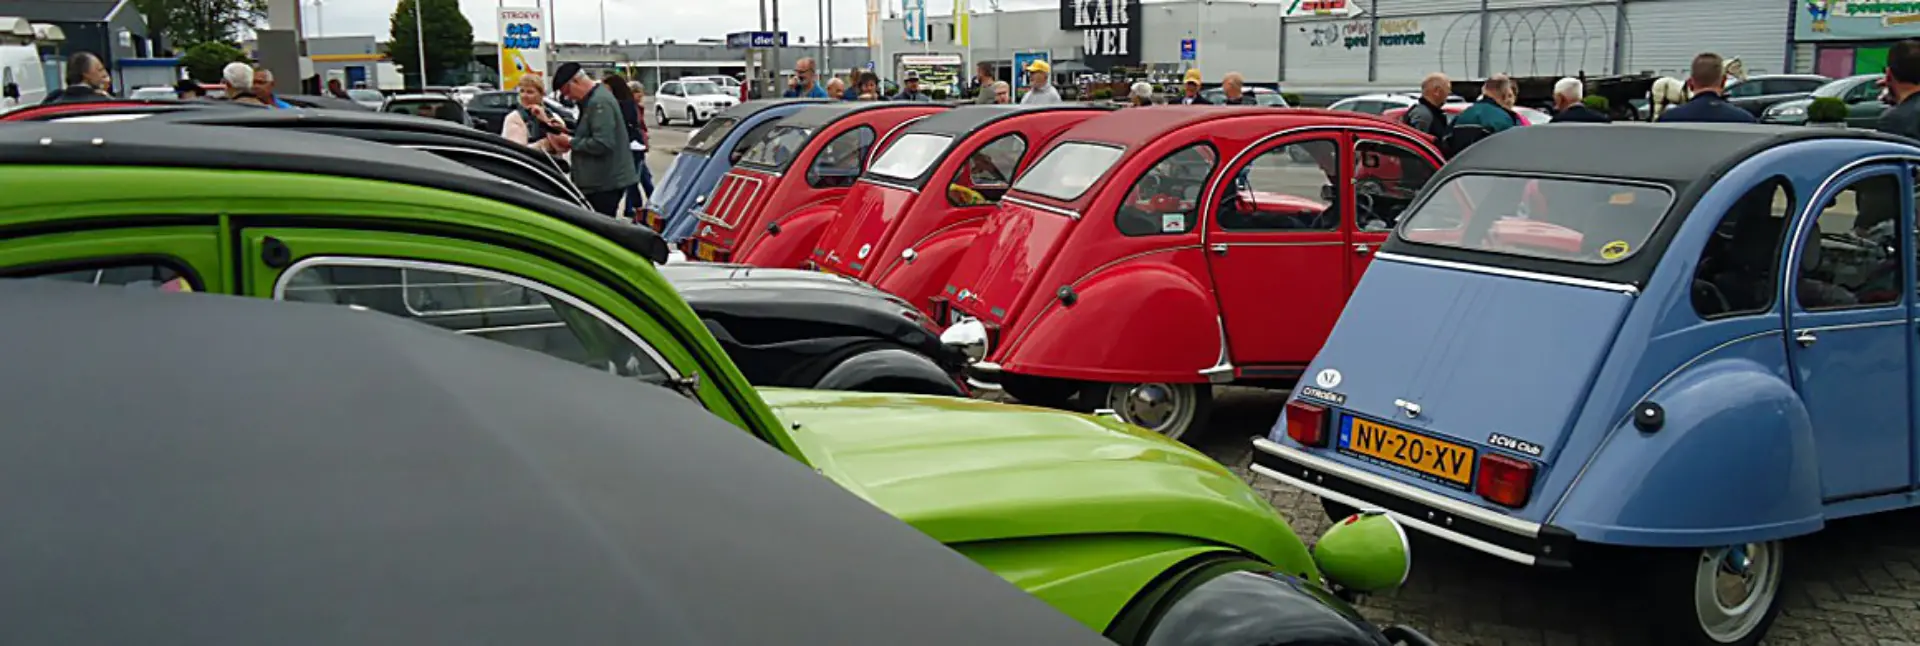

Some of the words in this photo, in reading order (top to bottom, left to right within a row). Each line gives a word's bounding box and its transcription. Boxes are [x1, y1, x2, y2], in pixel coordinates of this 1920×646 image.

[1074, 0, 1129, 26] KAR
[503, 36, 540, 49] WASH
[1083, 27, 1129, 55] WEI
[1356, 423, 1466, 476] NV-20-XV
